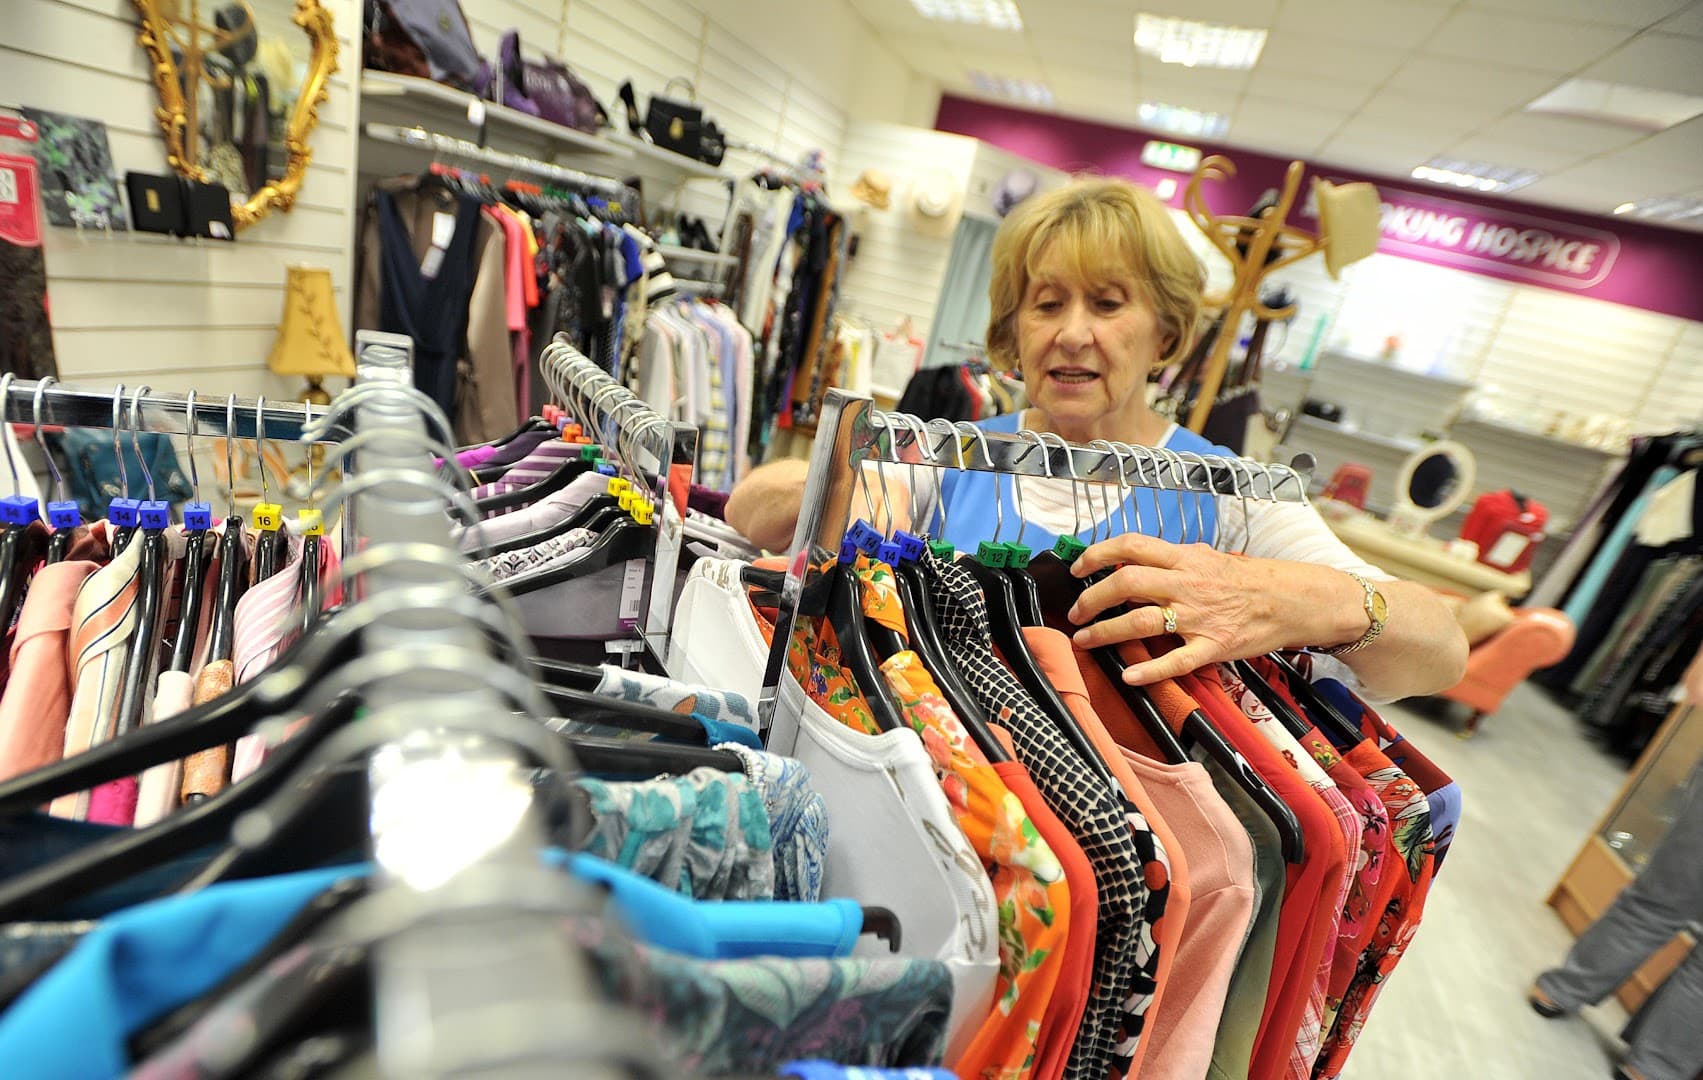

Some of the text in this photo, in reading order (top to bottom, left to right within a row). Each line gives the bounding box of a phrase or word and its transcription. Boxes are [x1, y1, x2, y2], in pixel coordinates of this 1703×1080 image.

[1377, 202, 1602, 274] OKING HOSPICE
[56, 513, 73, 523] 14
[114, 511, 130, 521] 14
[146, 514, 161, 523] 14
[189, 515, 204, 526] 14
[257, 516, 271, 526] 16
[851, 525, 863, 539] 14
[864, 537, 878, 549] 14
[904, 543, 918, 554] 14
[1057, 541, 1066, 553] 12
[884, 551, 896, 561] 14
[938, 551, 951, 560] 12
[980, 547, 987, 560] 12
[992, 552, 1004, 563] 12
[1018, 553, 1029, 564] 12
